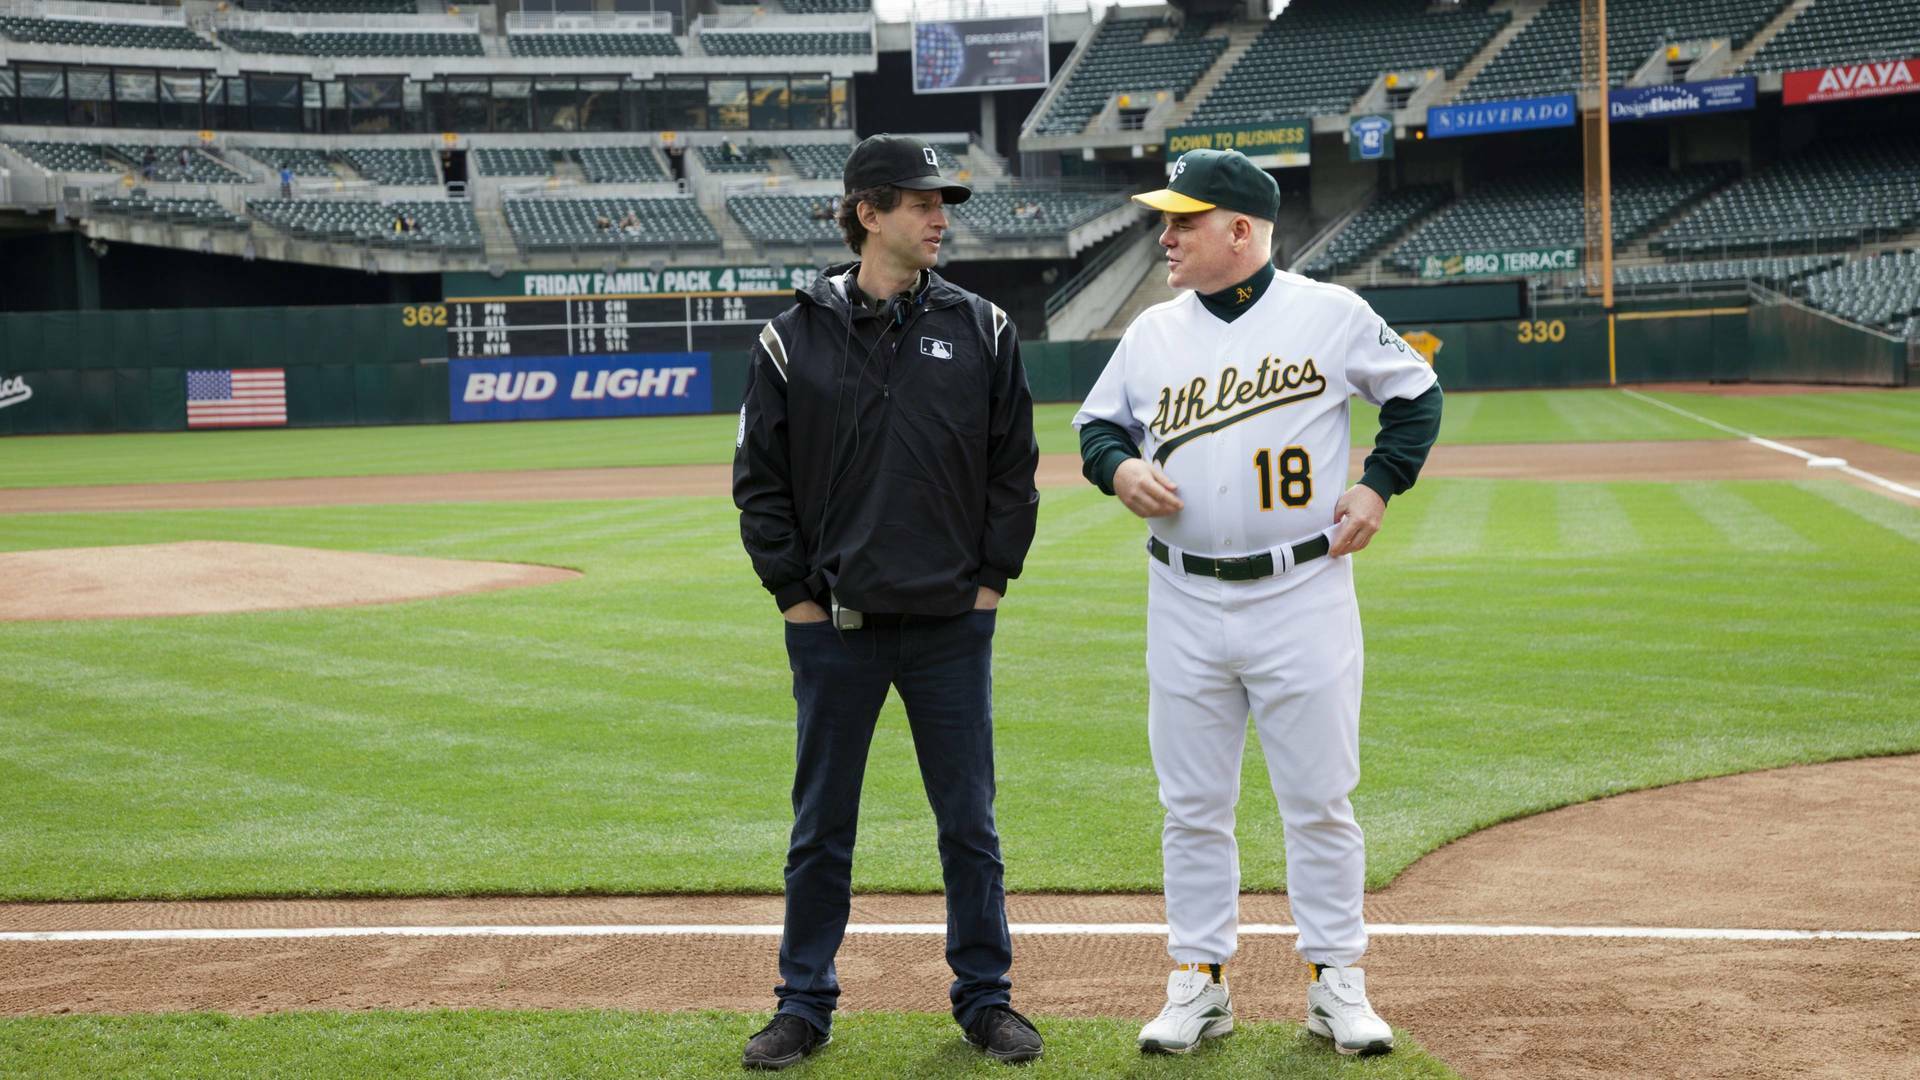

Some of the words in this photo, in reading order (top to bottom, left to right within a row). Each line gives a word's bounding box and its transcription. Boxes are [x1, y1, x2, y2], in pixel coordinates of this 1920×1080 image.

[1818, 62, 1913, 91] AVAYA
[1456, 102, 1568, 128] SILVERADO
[1170, 134, 1212, 152] DOWN
[1216, 133, 1234, 148] TO
[1235, 127, 1305, 147] BUSINESS
[1363, 130, 1380, 148] 42
[1464, 254, 1499, 273] BBQ
[1503, 249, 1577, 272] TERRACE
[525, 274, 590, 296] FRIDAY
[594, 271, 658, 294] FAMILY
[664, 270, 712, 292] PACK
[717, 269, 737, 291] 4
[738, 267, 786, 280] TICKETS
[738, 280, 778, 291] MEALS
[1235, 286, 1253, 304] A's
[403, 305, 448, 327] 362
[484, 303, 506, 315] PHI
[605, 300, 627, 312] CHI
[605, 312, 628, 324] CIN
[1518, 320, 1565, 343] 330
[483, 342, 511, 354] NYM
[463, 372, 558, 402] BUD
[570, 367, 697, 400] LIGHT
[1148, 353, 1328, 437] Athletics
[1253, 445, 1314, 512] 18
